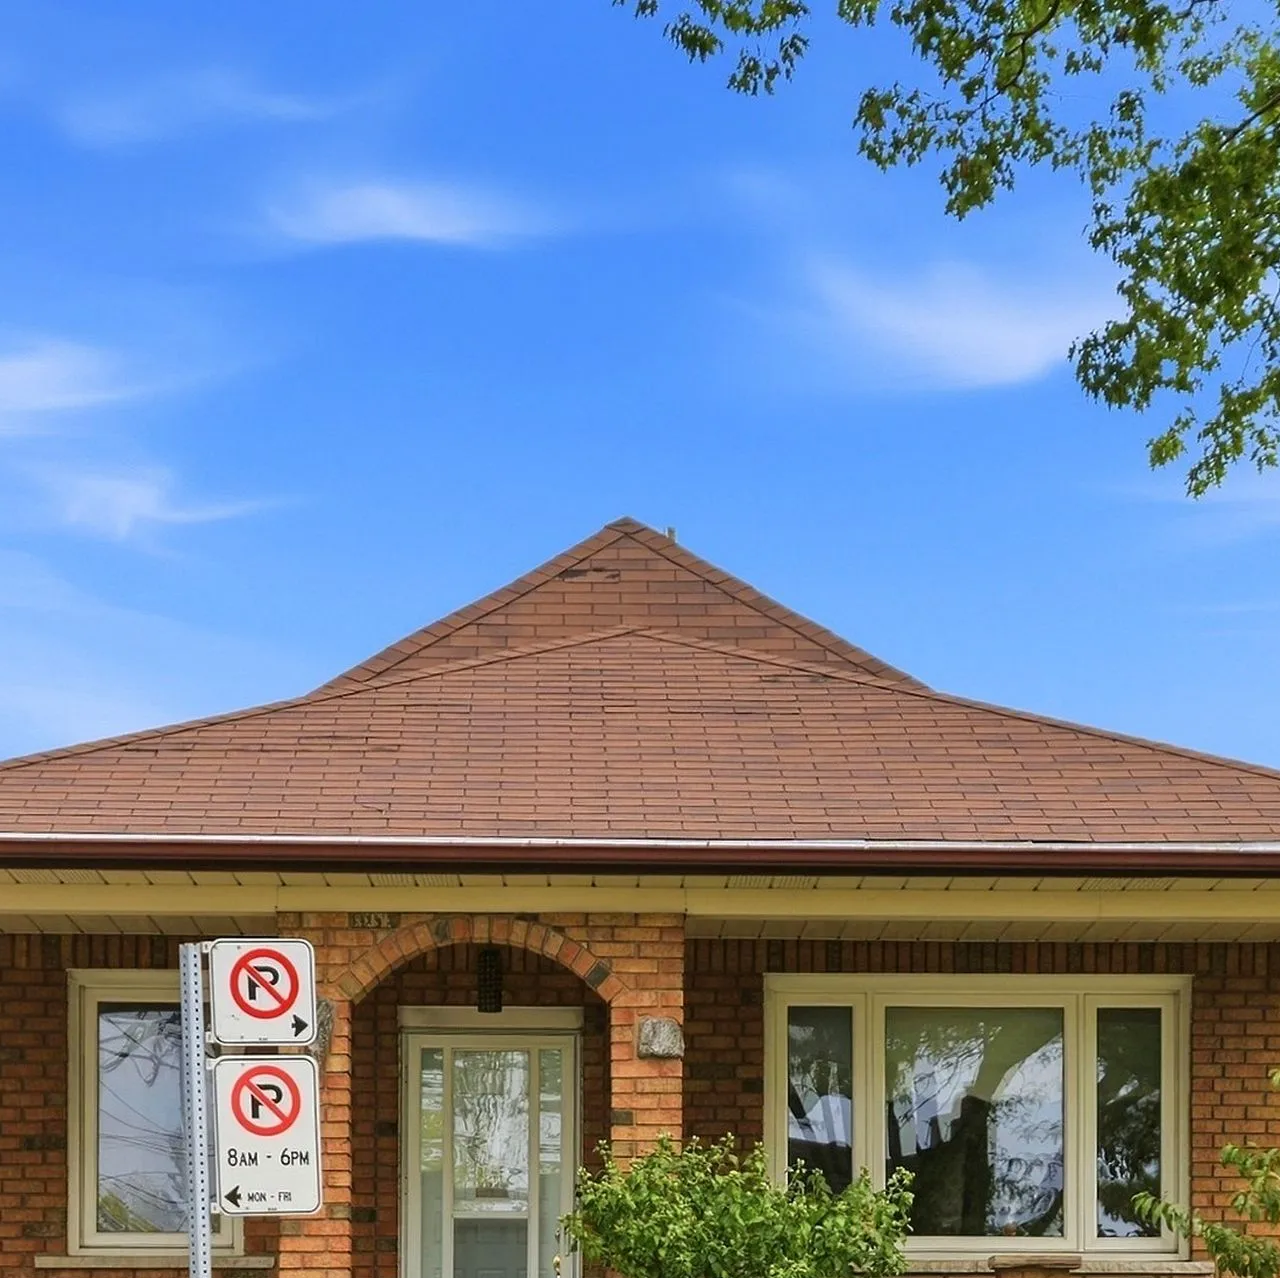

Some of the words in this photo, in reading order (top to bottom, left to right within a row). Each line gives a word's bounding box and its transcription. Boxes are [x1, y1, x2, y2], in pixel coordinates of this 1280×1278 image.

[227, 1148, 259, 1167] 8AM
[280, 1147, 310, 1166] 6PM
[247, 1191, 268, 1202] MON
[278, 1191, 292, 1202] FRI
